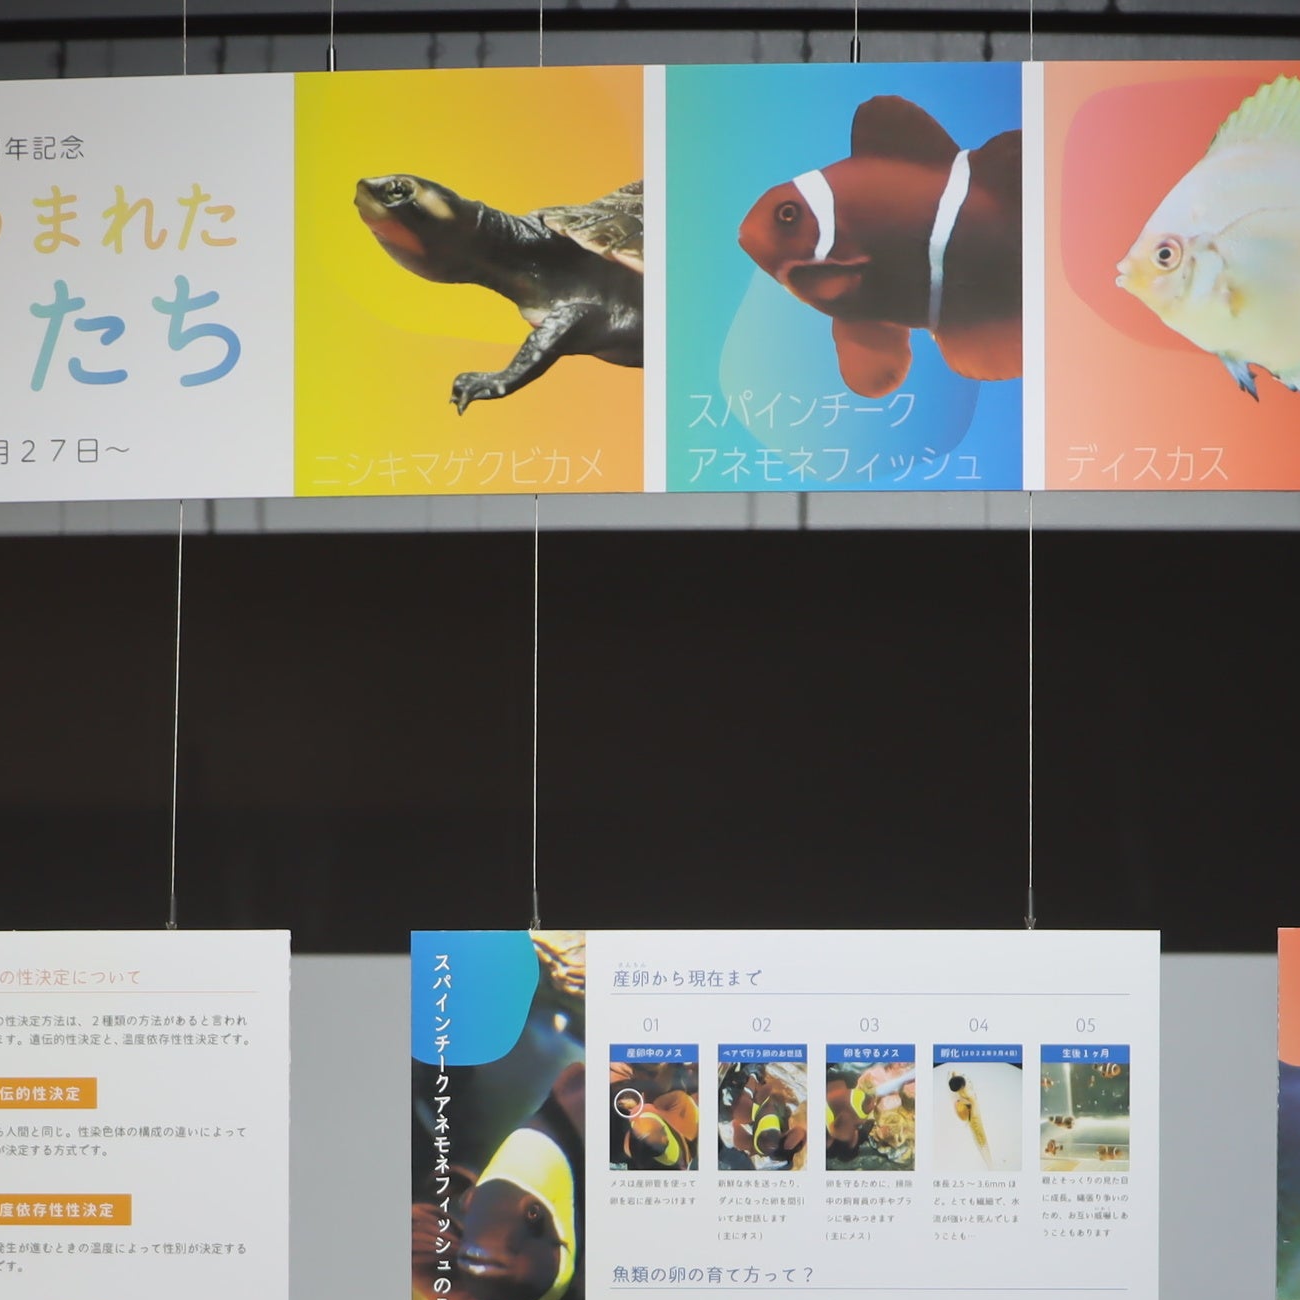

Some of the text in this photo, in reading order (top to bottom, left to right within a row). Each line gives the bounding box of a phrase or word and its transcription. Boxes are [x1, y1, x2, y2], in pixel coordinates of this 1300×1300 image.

[687, 390, 916, 429] スパインチーク
[687, 446, 983, 483] アネモネフィッシュ
[1066, 444, 1229, 482] ディスカス
[612, 969, 762, 988] 産卵から現在まで
[643, 1018, 659, 1032] 01
[752, 1018, 772, 1033] 02
[859, 1018, 880, 1033] 03
[968, 1018, 989, 1032] 04
[1076, 1018, 1096, 1033] 05
[626, 1048, 683, 1059] 産卵中のメス
[843, 1048, 900, 1059] 卵を守るメス
[609, 1197, 696, 1206] 卵を岩に産みつけます
[718, 1196, 805, 1206] ダメになった卵を間引
[718, 1214, 787, 1223] いてお世話します
[1043, 1228, 1111, 1238] うこともあります
